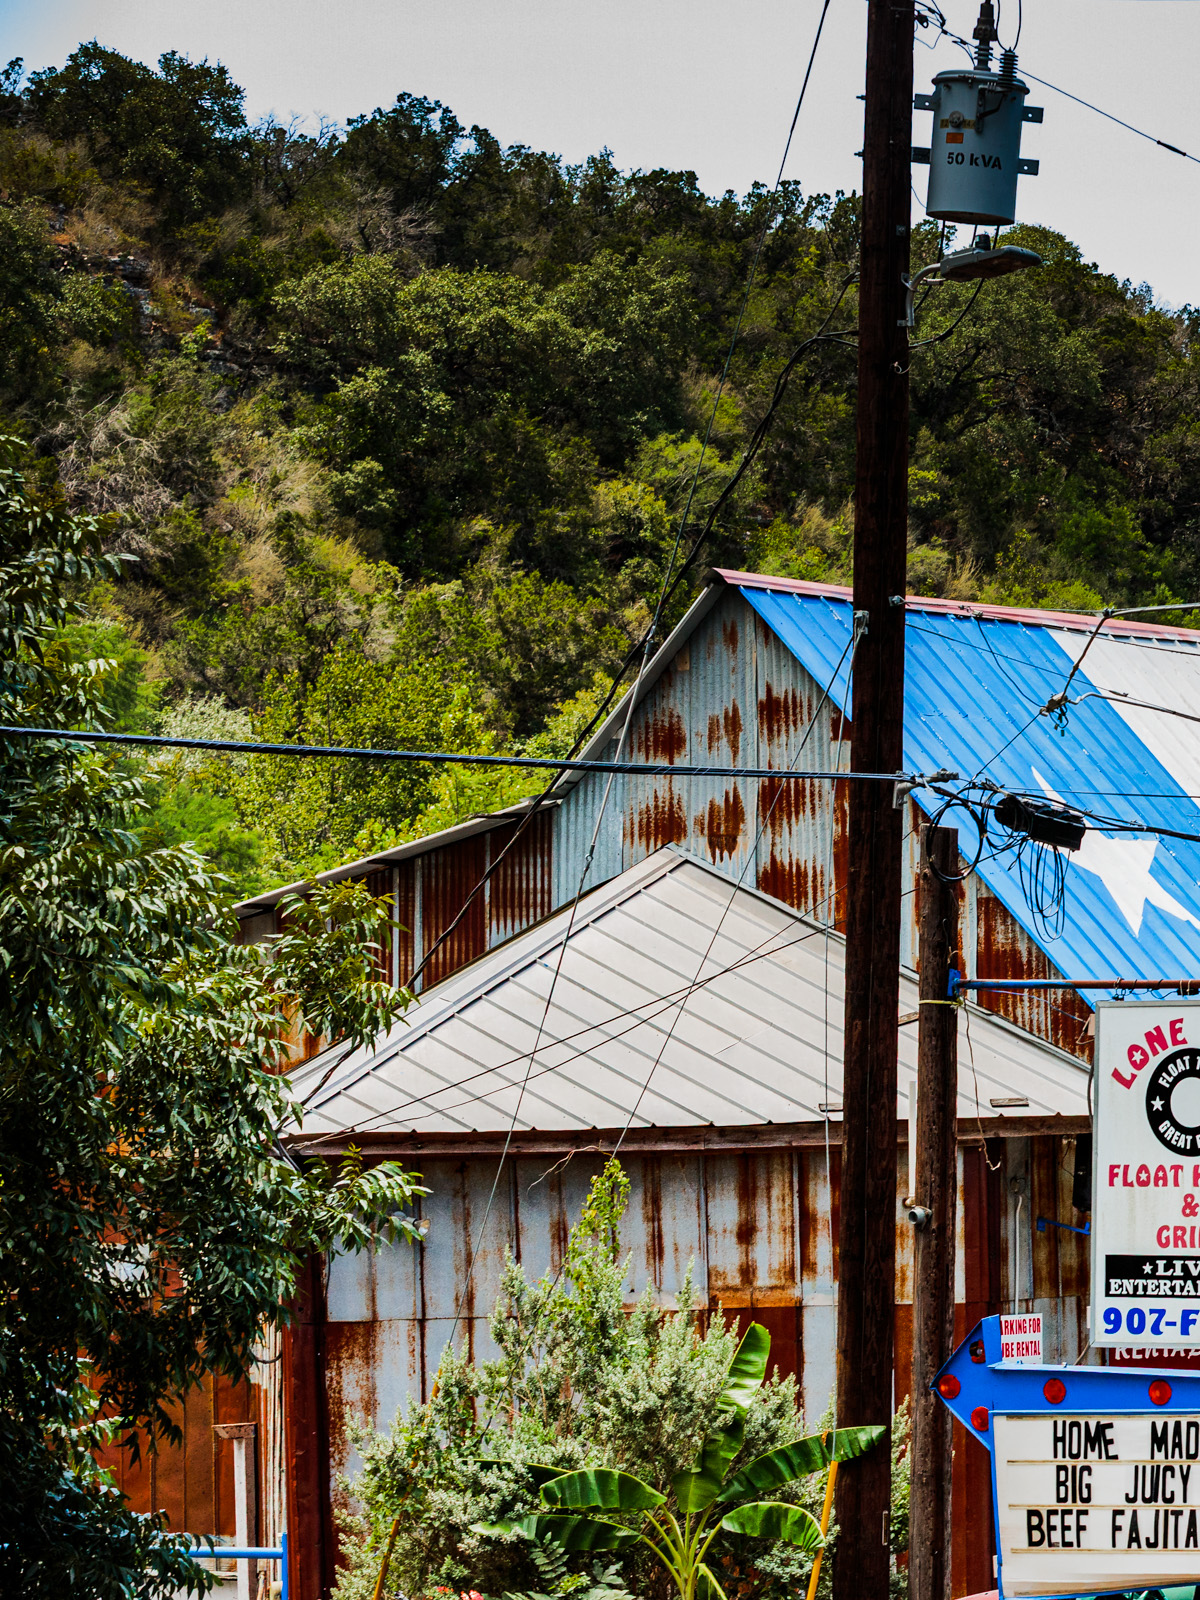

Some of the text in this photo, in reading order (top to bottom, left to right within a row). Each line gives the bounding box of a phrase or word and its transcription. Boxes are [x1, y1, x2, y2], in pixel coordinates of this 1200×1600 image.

[946, 152, 1002, 170] 50 kVA
[1111, 1018, 1188, 1090] LONE
[1158, 1055, 1191, 1089] FLOAT
[1158, 1119, 1192, 1150] GREAT
[1108, 1164, 1184, 1188] FLOAT
[1181, 1193, 1200, 1218] &
[1000, 1318, 1040, 1335] ARKING FOR
[1017, 1340, 1040, 1357] RENTAL
[1053, 1420, 1119, 1461] HOME
[1055, 1464, 1092, 1504] BIG
[1026, 1509, 1089, 1548] BEEF
[1111, 1509, 1199, 1549] FAJITA
